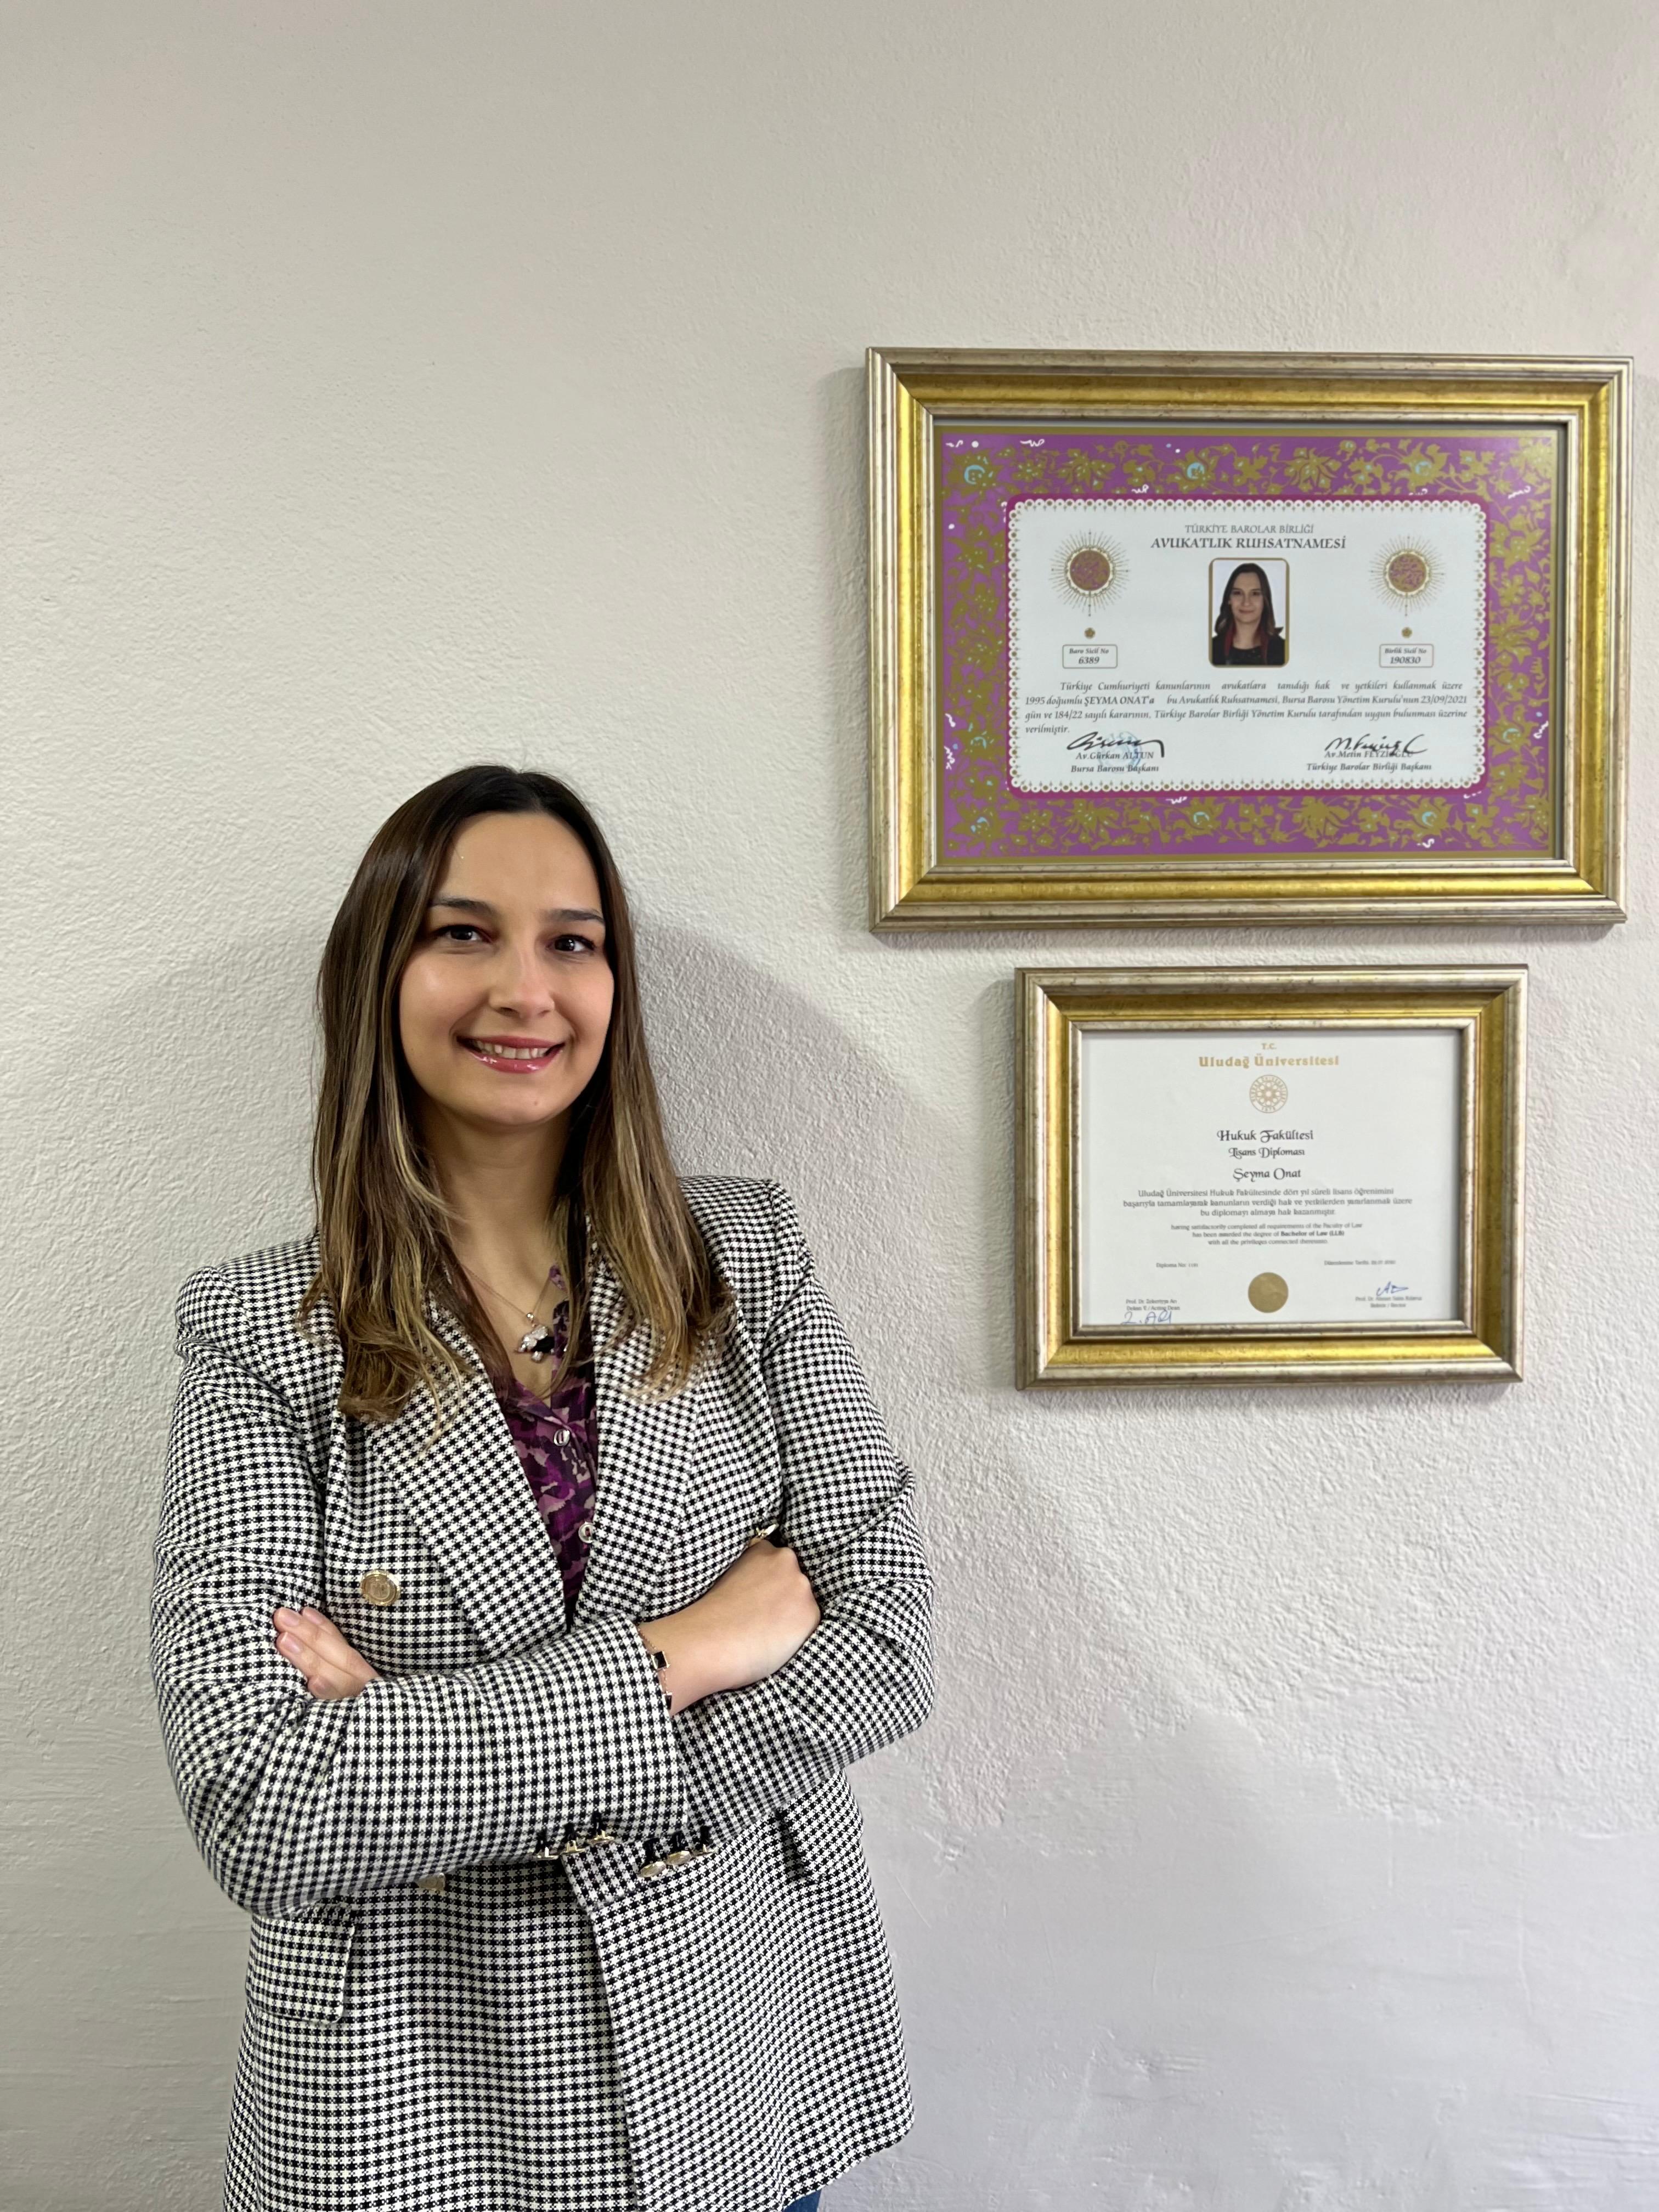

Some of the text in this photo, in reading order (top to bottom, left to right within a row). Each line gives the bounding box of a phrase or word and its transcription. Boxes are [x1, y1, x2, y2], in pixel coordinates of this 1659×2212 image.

[1185, 523, 1314, 534] TÜRKİYE BAROLAR BİRLİĞİ
[1152, 535, 1346, 548] AVUKATLIK RUHSATNAMESİ
[1060, 682, 1093, 693] Türkiye
[1098, 681, 1150, 693] Cumhuriyeti
[1155, 681, 1210, 690] kanunlarının
[1221, 681, 1266, 690] avukatlara
[1278, 681, 1309, 693] tanıdığı
[1316, 680, 1330, 690] hak
[1355, 680, 1387, 693] yetkileri
[1393, 680, 1436, 690] kullanmak
[1442, 681, 1463, 690] üzere
[1025, 697, 1045, 705] 1995
[1046, 695, 1082, 708] doğumlu
[1084, 696, 1118, 707] ŞEYMA
[1167, 695, 1178, 704] bu
[1179, 694, 1219, 704] Avukatlık
[1221, 694, 1280, 704] Ruhsatnamesi,
[1282, 695, 1305, 703] Bursa
[1307, 695, 1335, 703] Barosu
[1337, 695, 1370, 703] Yönetim
[1372, 695, 1419, 703] Kurulu'nun
[1420, 695, 1466, 704] 23/09/2021
[1025, 710, 1041, 722] gün
[1055, 710, 1082, 720] 184/22
[1084, 709, 1107, 721] sayılı
[1154, 710, 1186, 721] Türkiye
[1189, 709, 1220, 718] Barolar
[1222, 708, 1249, 721] Birliği
[1251, 709, 1284, 718] Yönetim
[1287, 709, 1316, 718] Kurulu
[1318, 708, 1362, 720] tarafından
[1365, 710, 1391, 720] uygun
[1393, 708, 1436, 718] bulunması
[1438, 709, 1467, 718] üzerine
[1025, 725, 1070, 735] verilmiştir.
[1122, 752, 1154, 760] ALTUN
[1071, 763, 1159, 774] Bursa Barosu Başkanı
[1307, 762, 1431, 774] Türkiye Barolar Birliği Başkanı
[1199, 1053, 1339, 1069] Uludağ Üniversitesi
[1217, 1130, 1314, 1143] Hukuk Fakültesi
[1228, 1147, 1305, 1159] Lisans Diploması
[1233, 1168, 1301, 1182] Şeyma Onat
[1138, 1189, 1164, 1198] Uludağ
[1166, 1188, 1207, 1197] Üniversitesi
[1301, 1188, 1310, 1197] yıl
[1354, 1187, 1393, 1196] öğrenimini
[1252, 1199, 1276, 1207] verdiği
[1211, 1209, 1248, 1217] diplomayı
